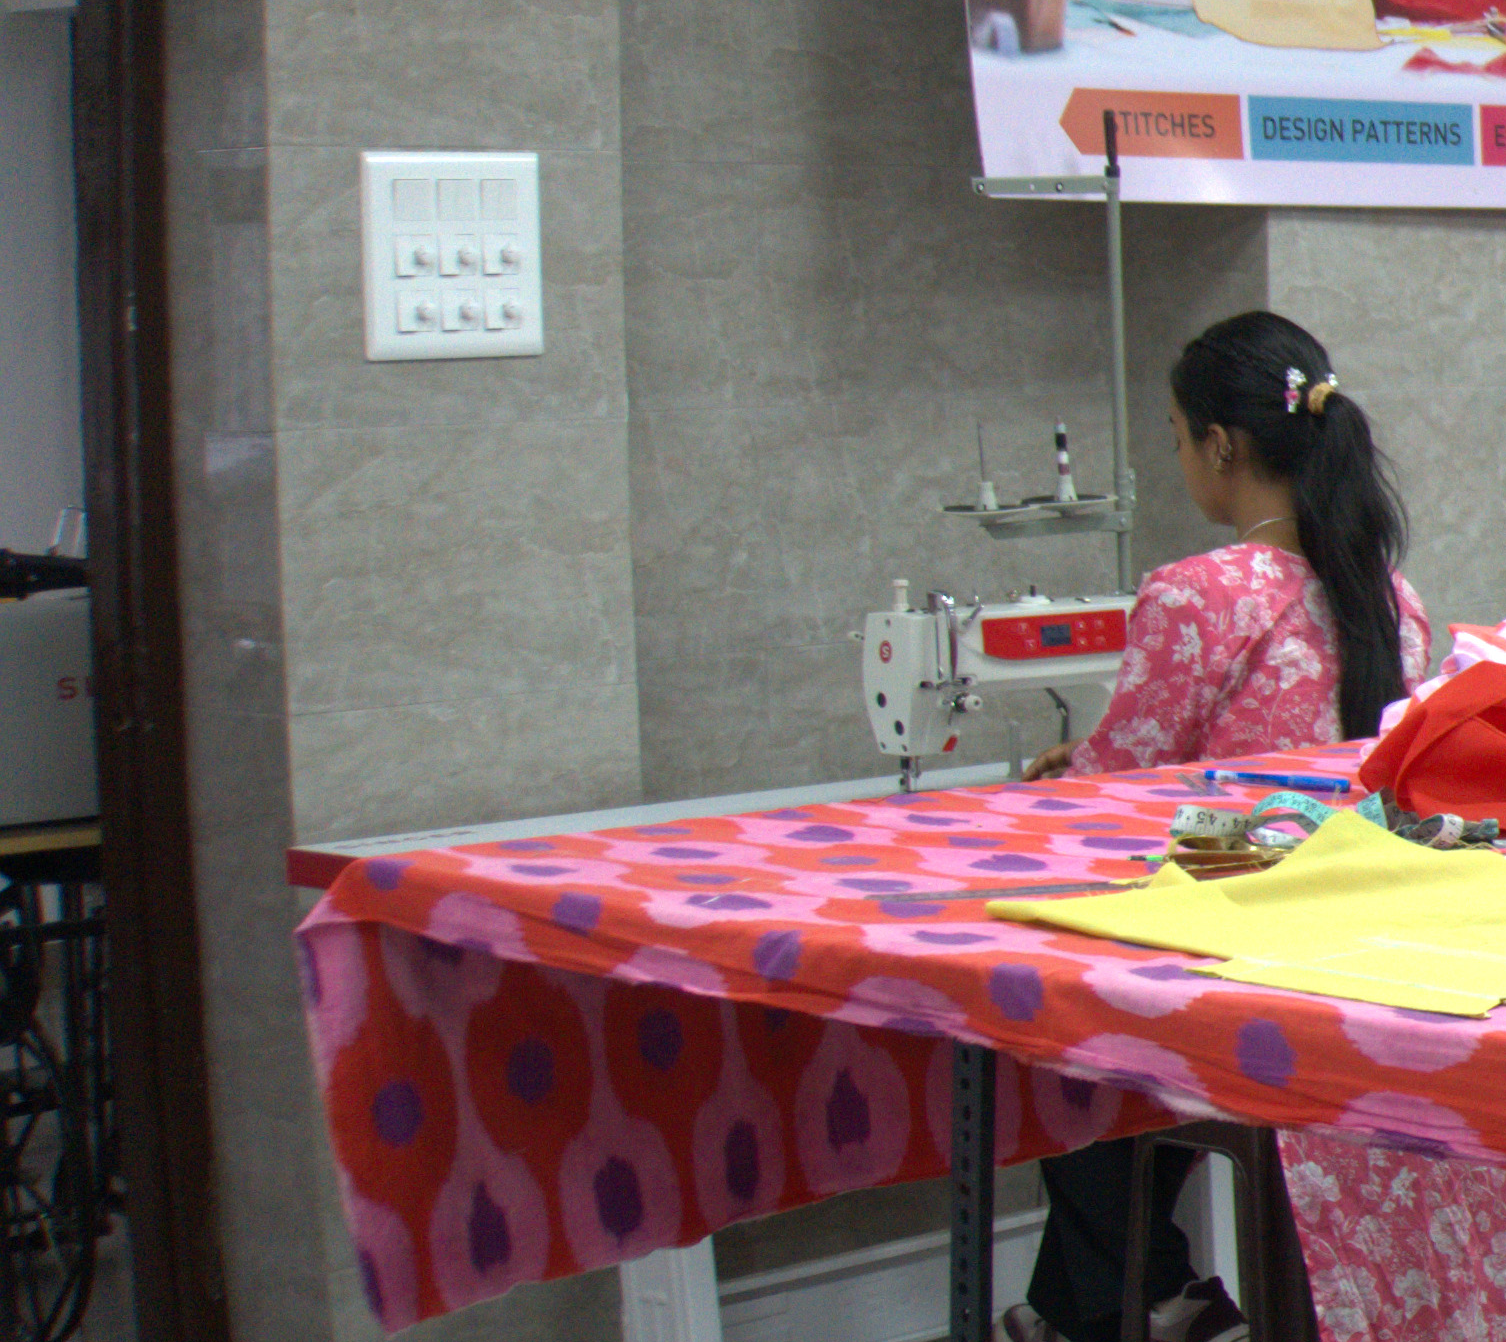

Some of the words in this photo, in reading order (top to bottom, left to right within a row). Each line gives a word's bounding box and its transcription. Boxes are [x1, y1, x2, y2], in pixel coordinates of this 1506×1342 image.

[1109, 110, 1216, 139] TITCHES
[1262, 115, 1345, 142] DESIGN
[1352, 119, 1463, 147] PATTERNS
[1197, 810, 1218, 825] 45
